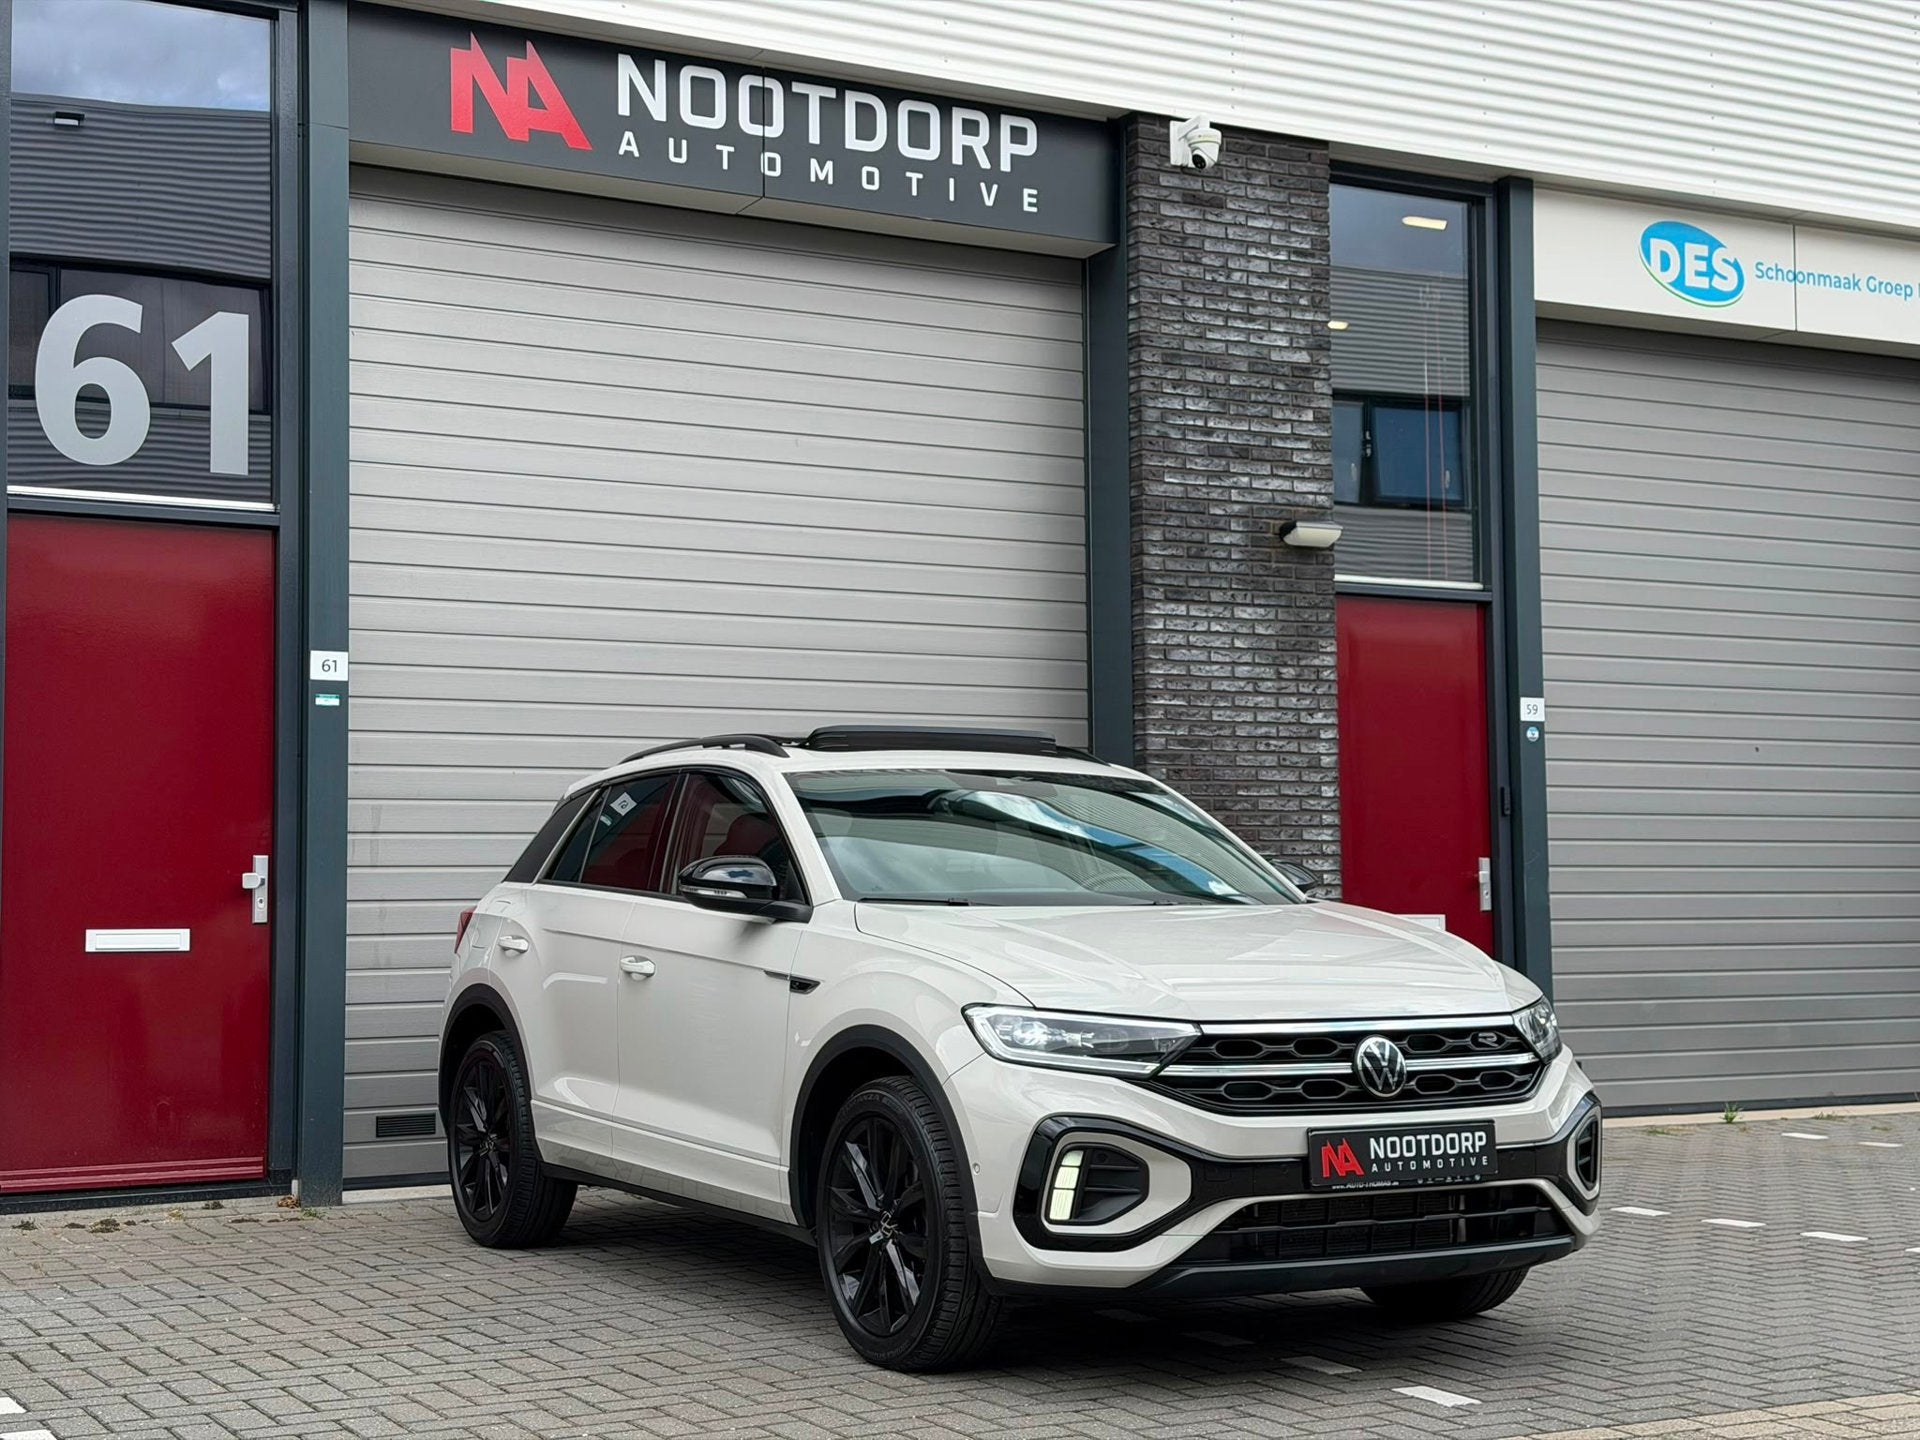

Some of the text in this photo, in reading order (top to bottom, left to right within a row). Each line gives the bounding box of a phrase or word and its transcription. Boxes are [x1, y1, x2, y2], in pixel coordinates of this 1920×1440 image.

[617, 53, 1038, 172] NOOTDORP
[618, 130, 1038, 213] AUTOMOTIVE
[1650, 237, 1738, 293] DES
[1755, 261, 1861, 291] Schoonmaak
[1866, 275, 1913, 301] Groep
[35, 294, 249, 475] 61
[321, 659, 337, 673] 61
[1526, 703, 1539, 715] 59
[1369, 1131, 1487, 1160] NOOTDORP
[1371, 1155, 1488, 1173] AUTOMOTIVE
